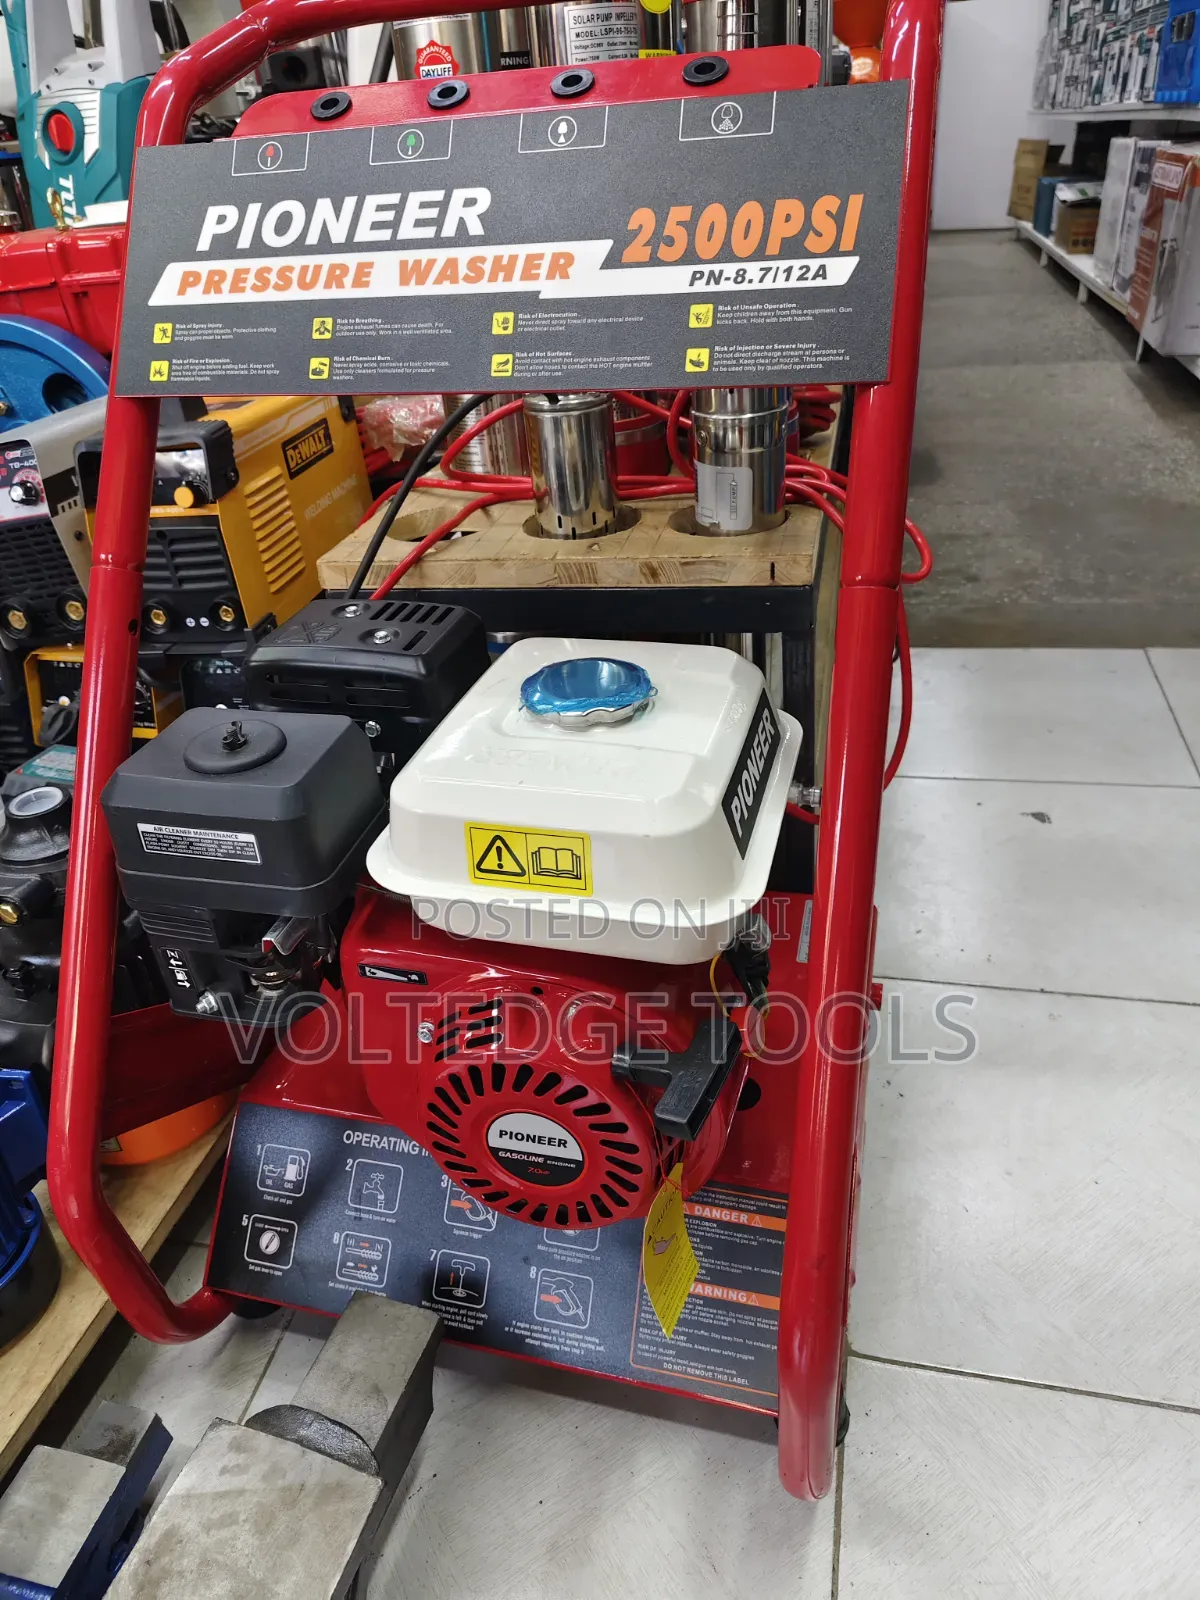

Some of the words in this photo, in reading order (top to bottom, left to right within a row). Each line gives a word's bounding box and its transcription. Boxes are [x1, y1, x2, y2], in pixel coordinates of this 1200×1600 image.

[572, 14, 594, 24] SOLAR
[596, 12, 612, 22] PUMP
[418, 45, 452, 64] GUARANTEED
[196, 188, 492, 252] PIONEER
[621, 193, 864, 262] 2500PSI
[177, 261, 374, 296] PRESSURE
[398, 252, 575, 287] WASHER
[731, 709, 776, 838] PIONEER
[192, 830, 238, 839] MAINTENANCE
[343, 1130, 419, 1155] OPERATING
[498, 1129, 568, 1148] PIONEER
[346, 1159, 352, 1171] 2
[498, 1150, 544, 1163] GASOLINE
[546, 1159, 576, 1168] ENGINE
[242, 1214, 249, 1226] 5
[695, 1205, 748, 1222] DANGER
[689, 1219, 716, 1227] EXPLOSION
[429, 1249, 437, 1261] 7
[530, 1266, 537, 1279] 8
[686, 1367, 712, 1377] REMOVE
[729, 1376, 749, 1385] LABEL
